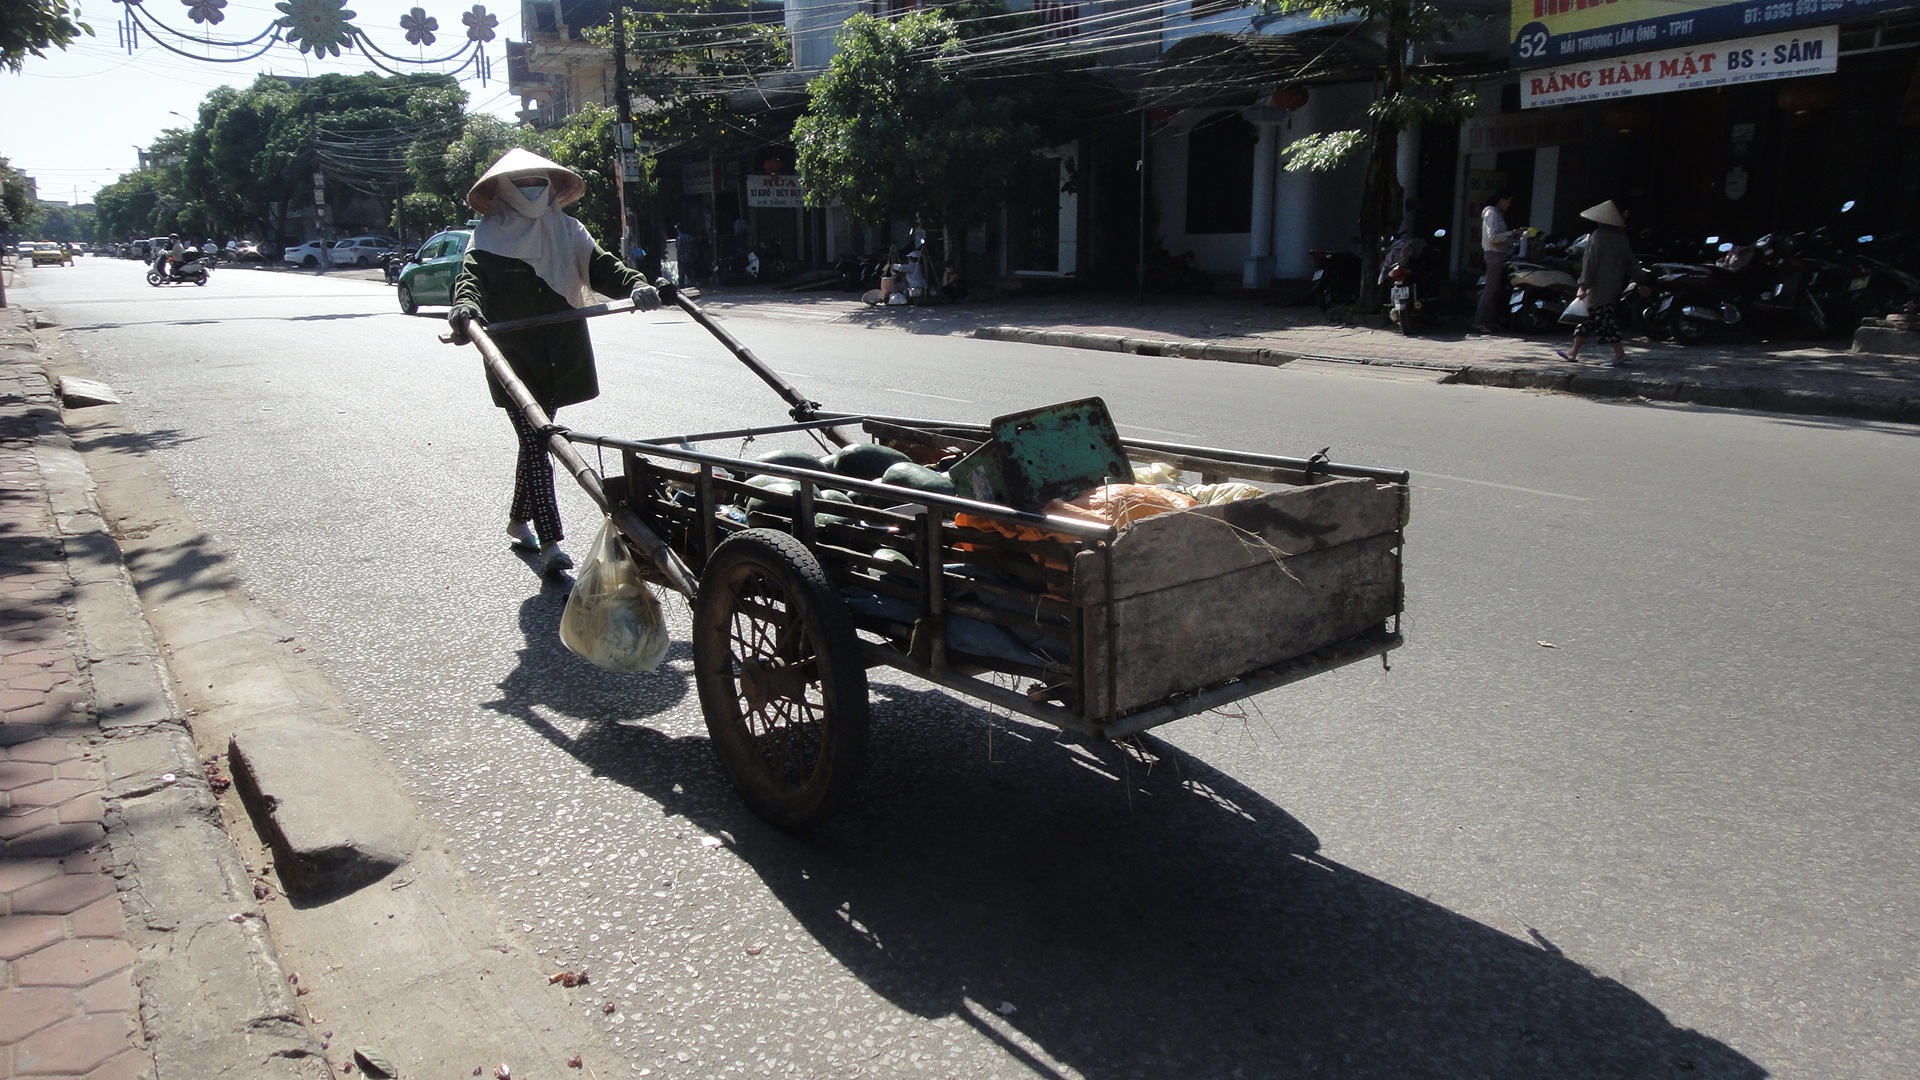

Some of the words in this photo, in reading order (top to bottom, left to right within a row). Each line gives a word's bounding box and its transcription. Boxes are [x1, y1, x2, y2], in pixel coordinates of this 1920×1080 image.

[1669, 19, 1694, 36] TPHT
[1519, 32, 1547, 58] 52
[1530, 70, 1593, 95] RĂNG
[1659, 51, 1717, 79] MẶT
[1727, 48, 1754, 70] BS
[1773, 38, 1823, 64] SÂM
